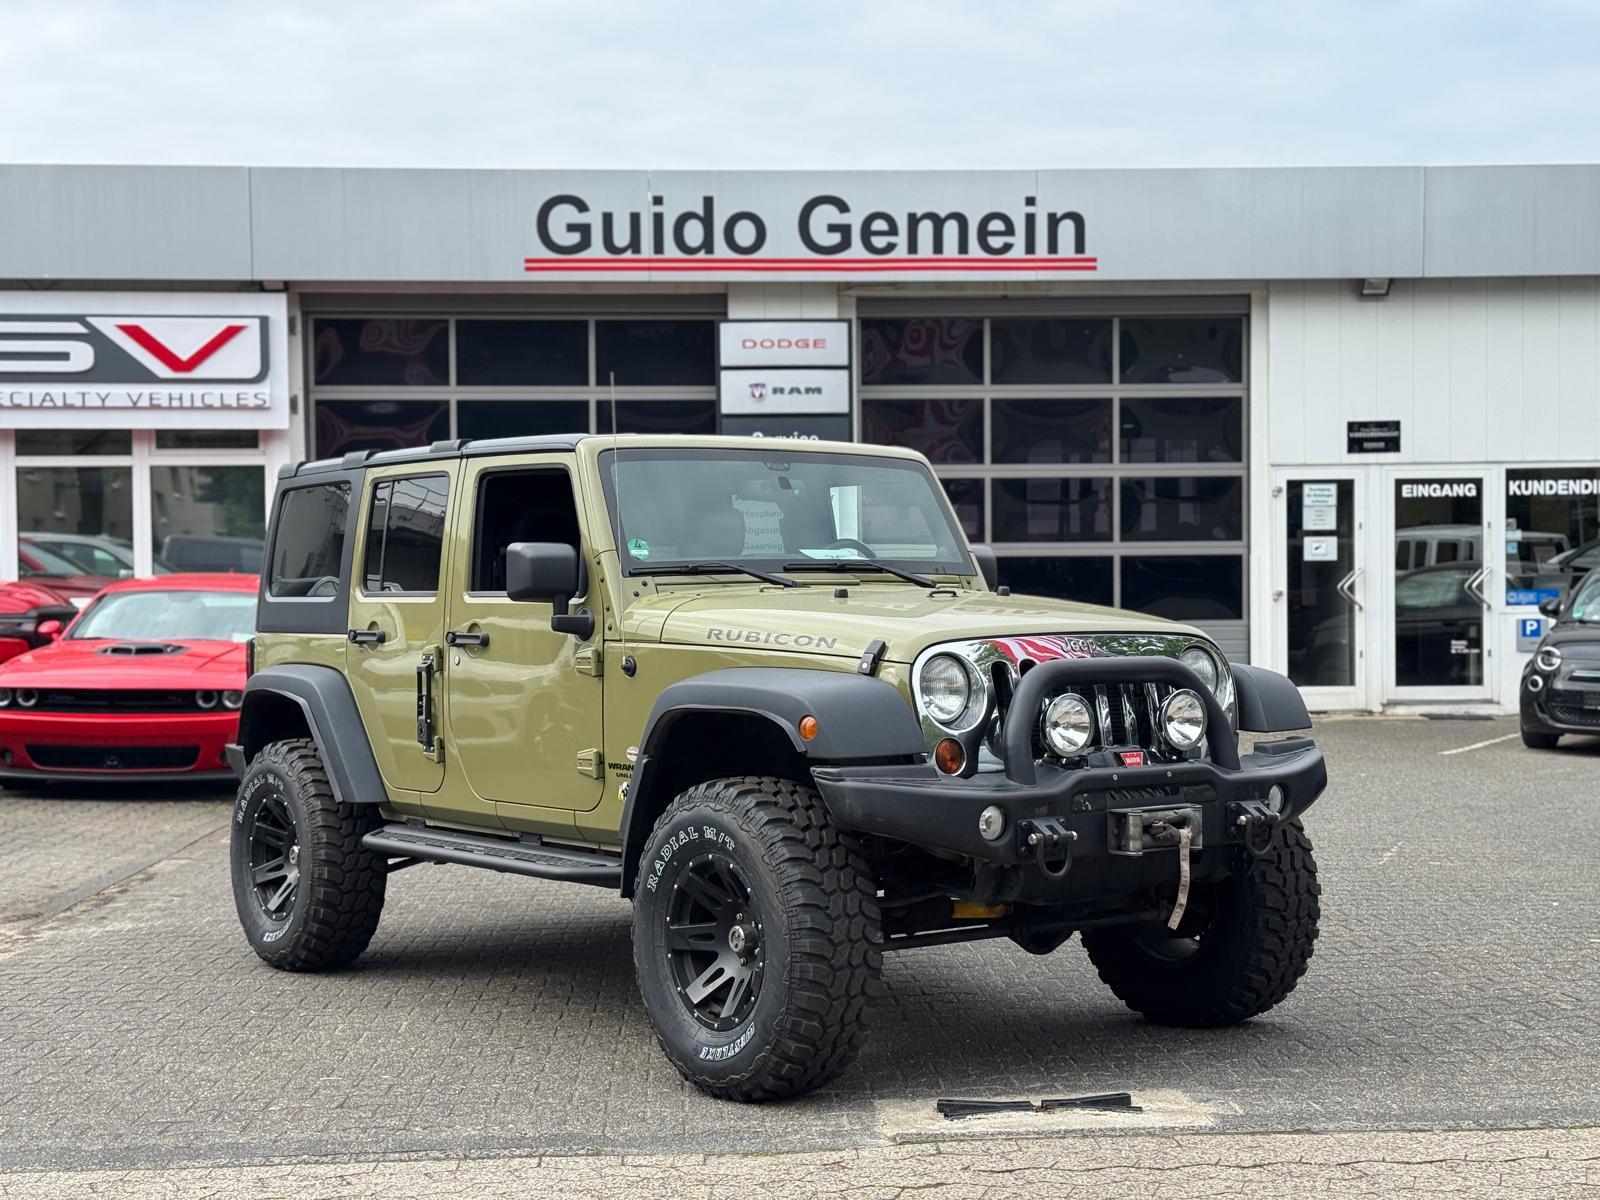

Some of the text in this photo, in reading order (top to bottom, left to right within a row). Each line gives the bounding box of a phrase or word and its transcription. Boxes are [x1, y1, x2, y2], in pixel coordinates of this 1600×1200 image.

[536, 194, 1087, 256] Guido Gemein
[742, 338, 827, 350] DODGE
[126, 391, 268, 408] VEHICLES
[772, 386, 823, 396] RAM
[1401, 483, 1477, 498] EINGANG
[634, 539, 642, 549] 4
[1525, 619, 1539, 636] P
[706, 628, 838, 649] RUBICON
[1061, 635, 1097, 655] Jeep
[646, 821, 736, 893] RADIAL M/T
